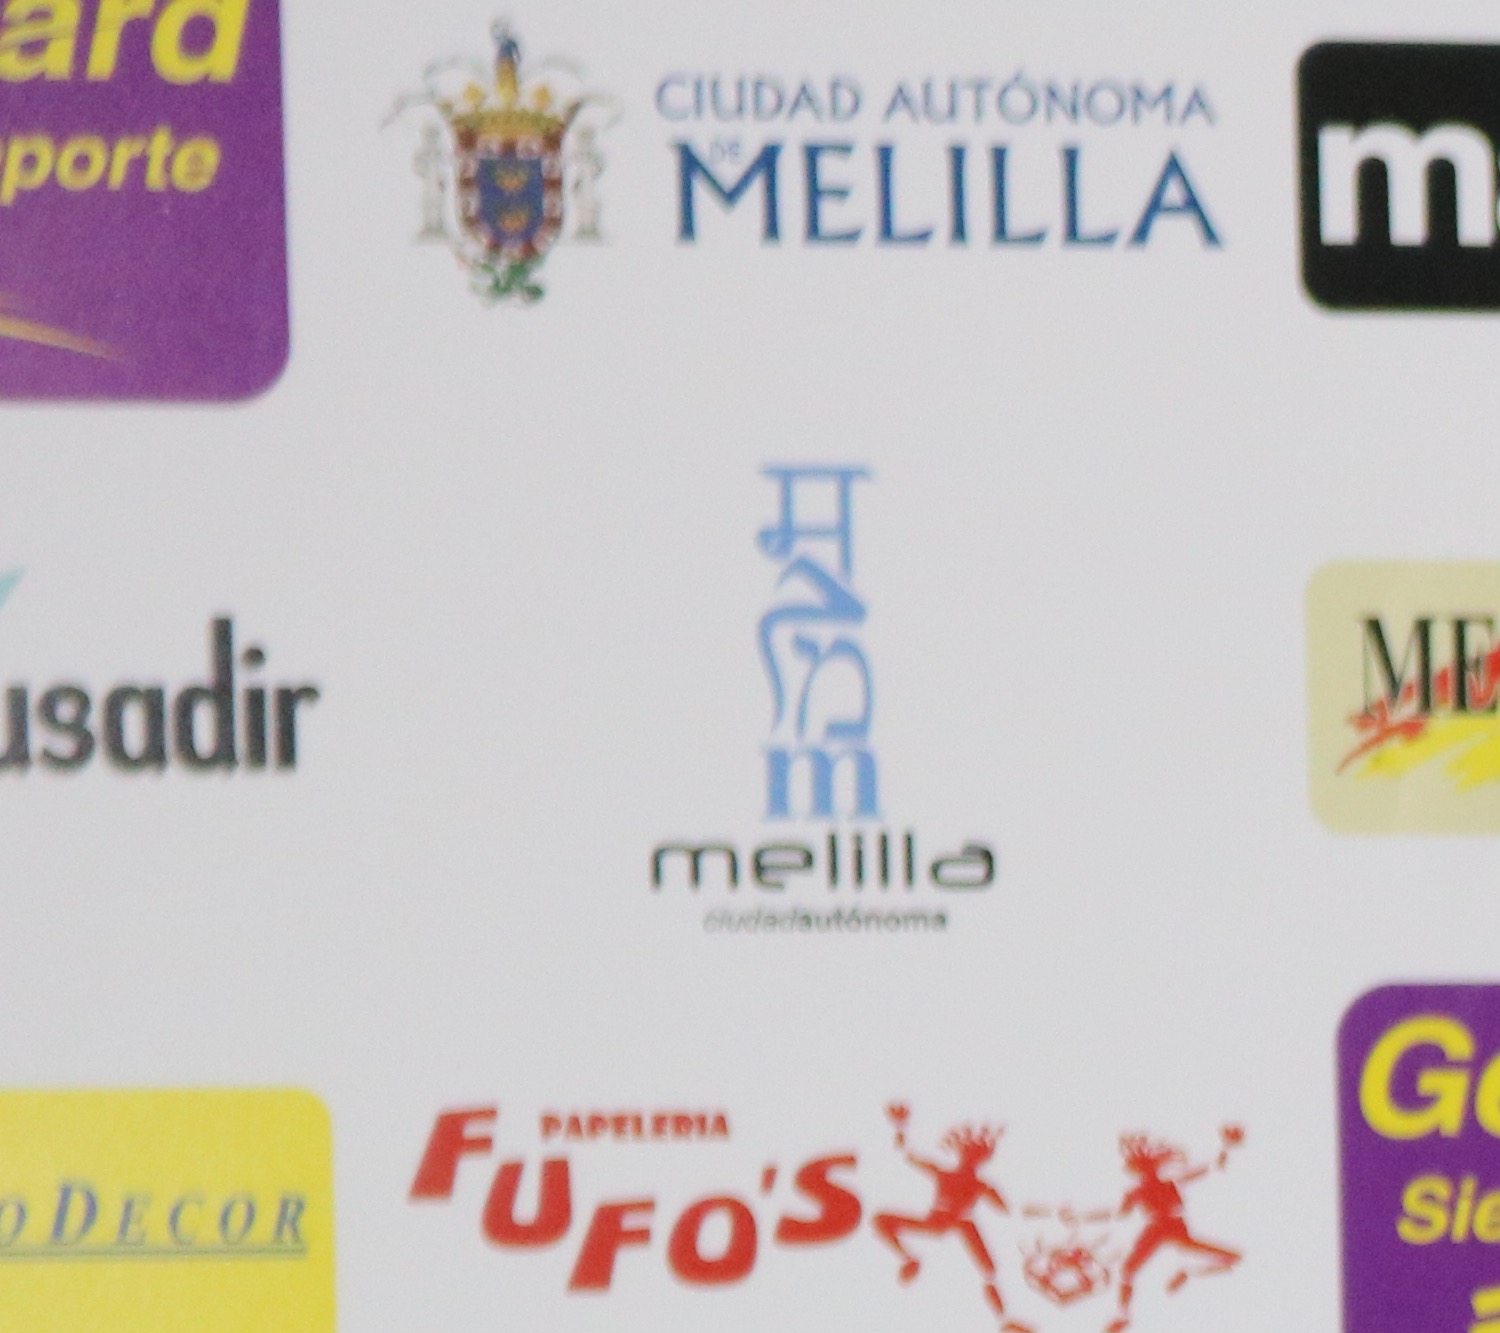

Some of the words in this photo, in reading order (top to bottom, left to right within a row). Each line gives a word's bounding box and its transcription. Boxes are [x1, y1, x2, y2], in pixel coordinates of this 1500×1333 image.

[654, 72, 861, 124] CIUDAD
[883, 68, 1217, 126] AUTÓNOMA
[709, 142, 742, 165] DE
[674, 142, 1224, 250] MELILLA
[650, 830, 998, 892] melilla
[540, 1112, 732, 1142] PAPELERIA
[408, 1106, 866, 1296] FUFO'S
